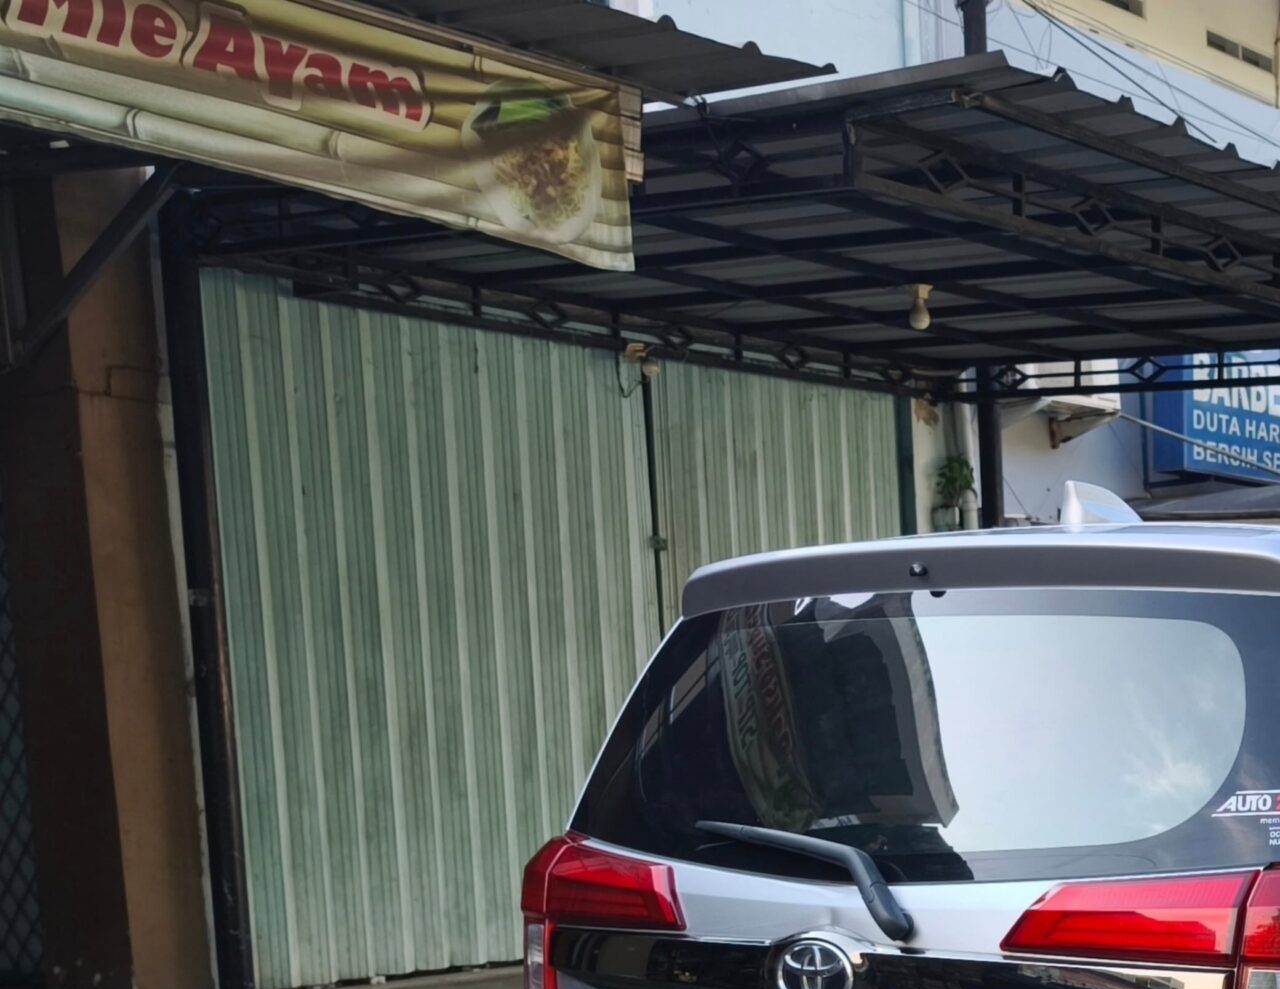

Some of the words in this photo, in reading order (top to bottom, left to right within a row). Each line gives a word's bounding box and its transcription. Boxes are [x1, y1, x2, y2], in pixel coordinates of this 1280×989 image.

[193, 16, 424, 122] Ayam
[1193, 409, 1240, 436] DUTA
[1193, 440, 1258, 469] BERSIH
[1216, 794, 1272, 812] AUTO
